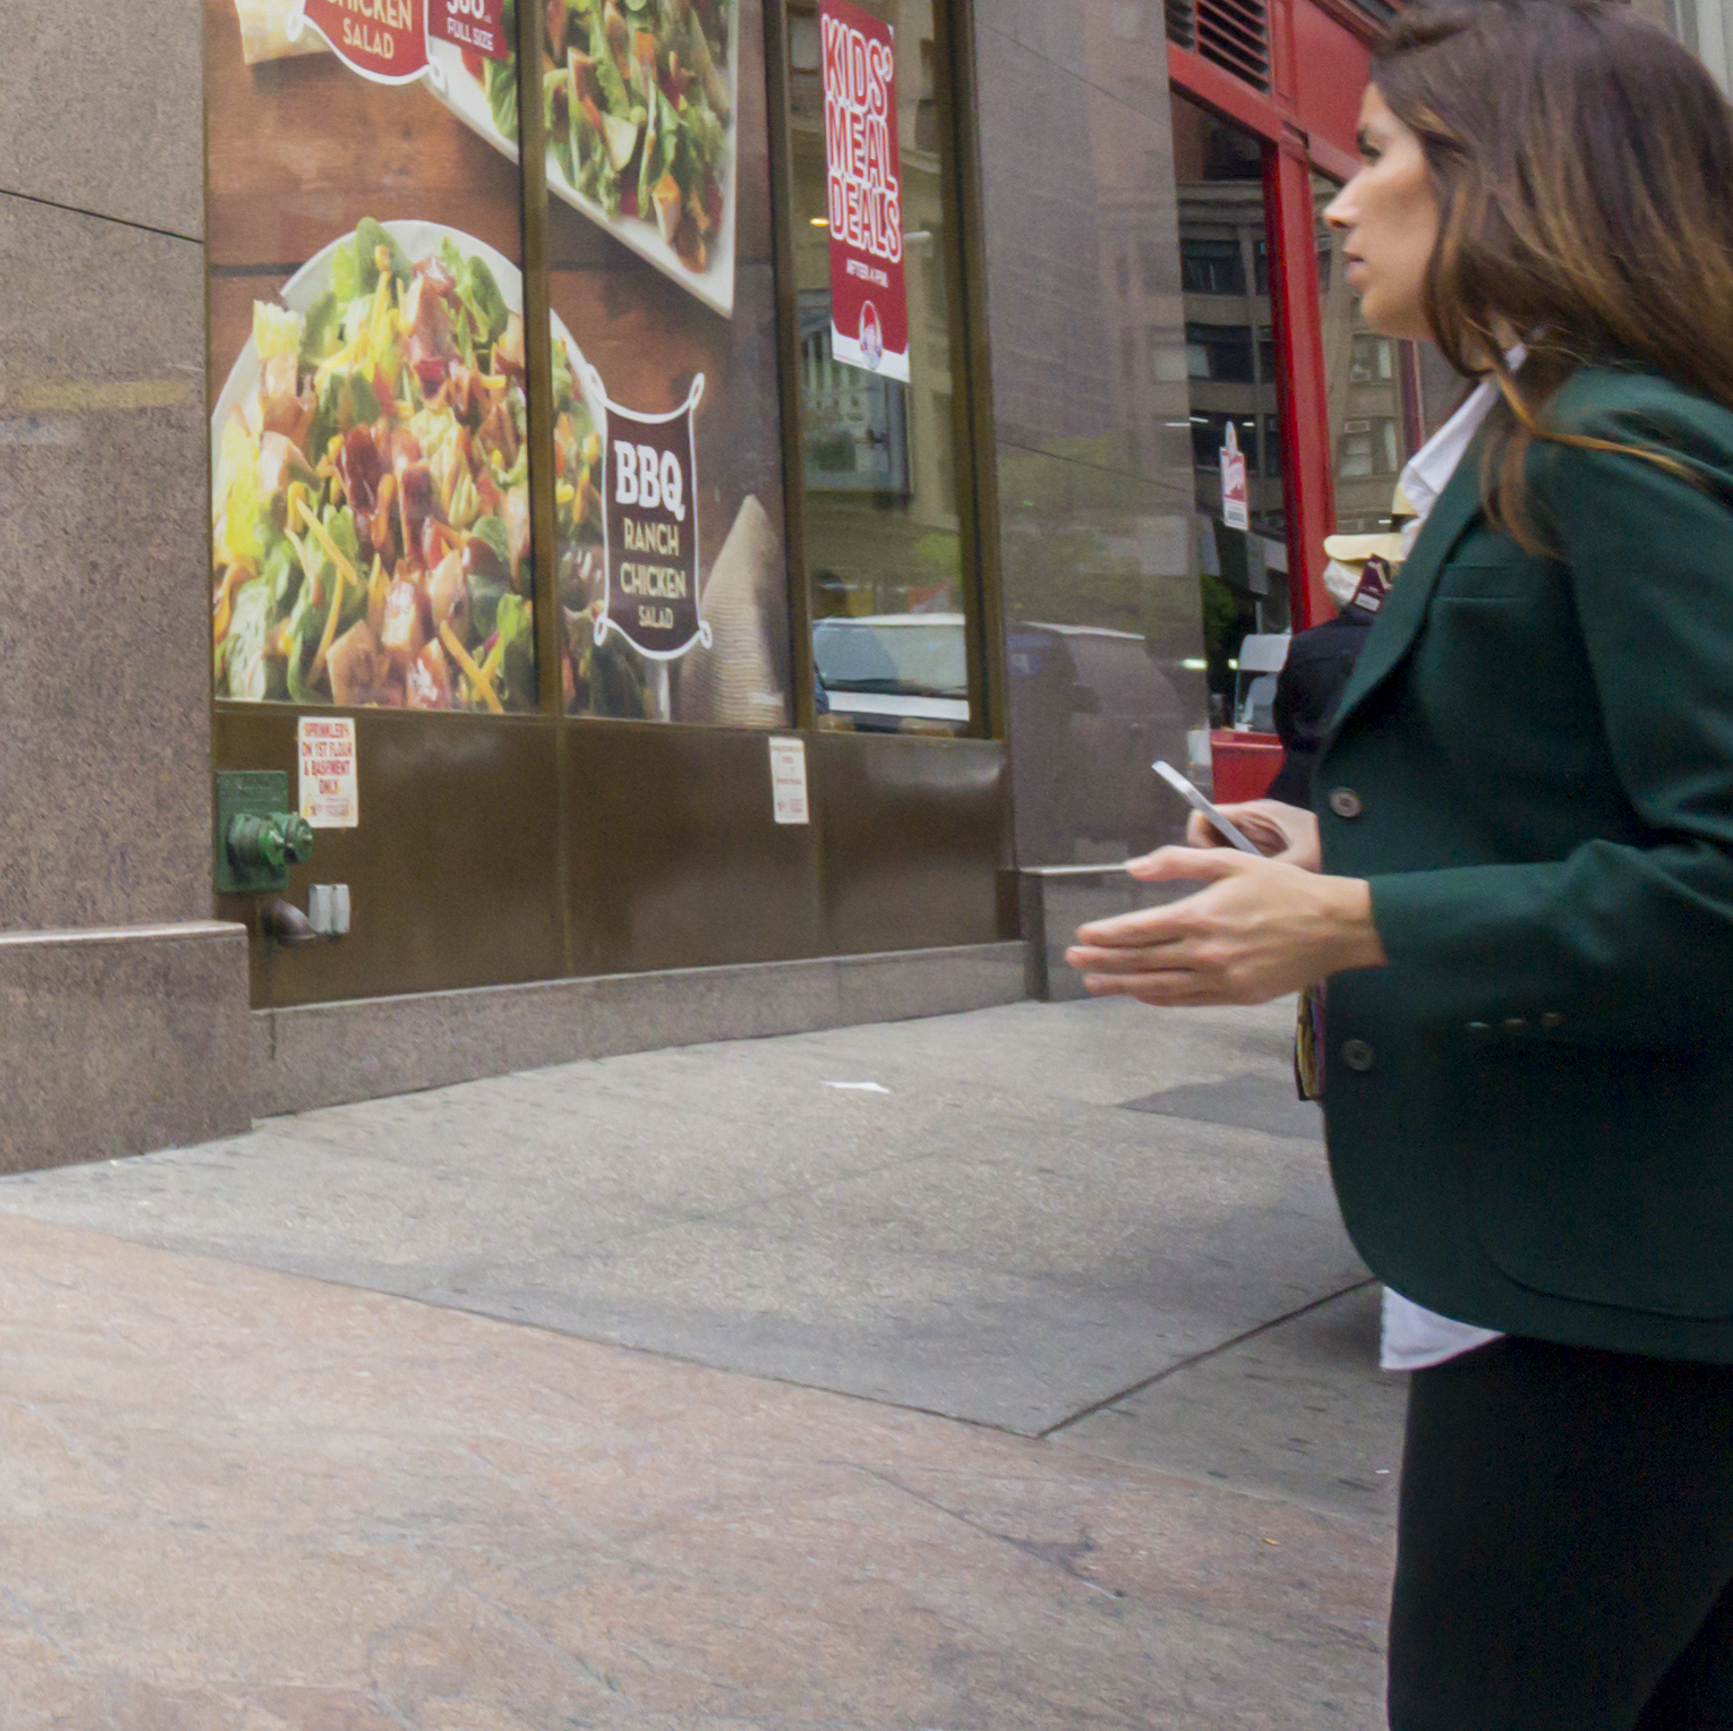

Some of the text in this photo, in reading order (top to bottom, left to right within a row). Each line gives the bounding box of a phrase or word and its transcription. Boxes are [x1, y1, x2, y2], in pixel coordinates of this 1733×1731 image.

[343, 17, 394, 59] SALAD
[447, 17, 494, 51] FULL SIZE
[820, 12, 894, 118] KIDS'
[825, 97, 898, 197] MEAL
[829, 168, 901, 263] DEALS
[614, 439, 685, 521] BBQ
[624, 517, 679, 556] RANCH
[620, 562, 686, 598] CHICKEN
[638, 605, 673, 629] SALAD
